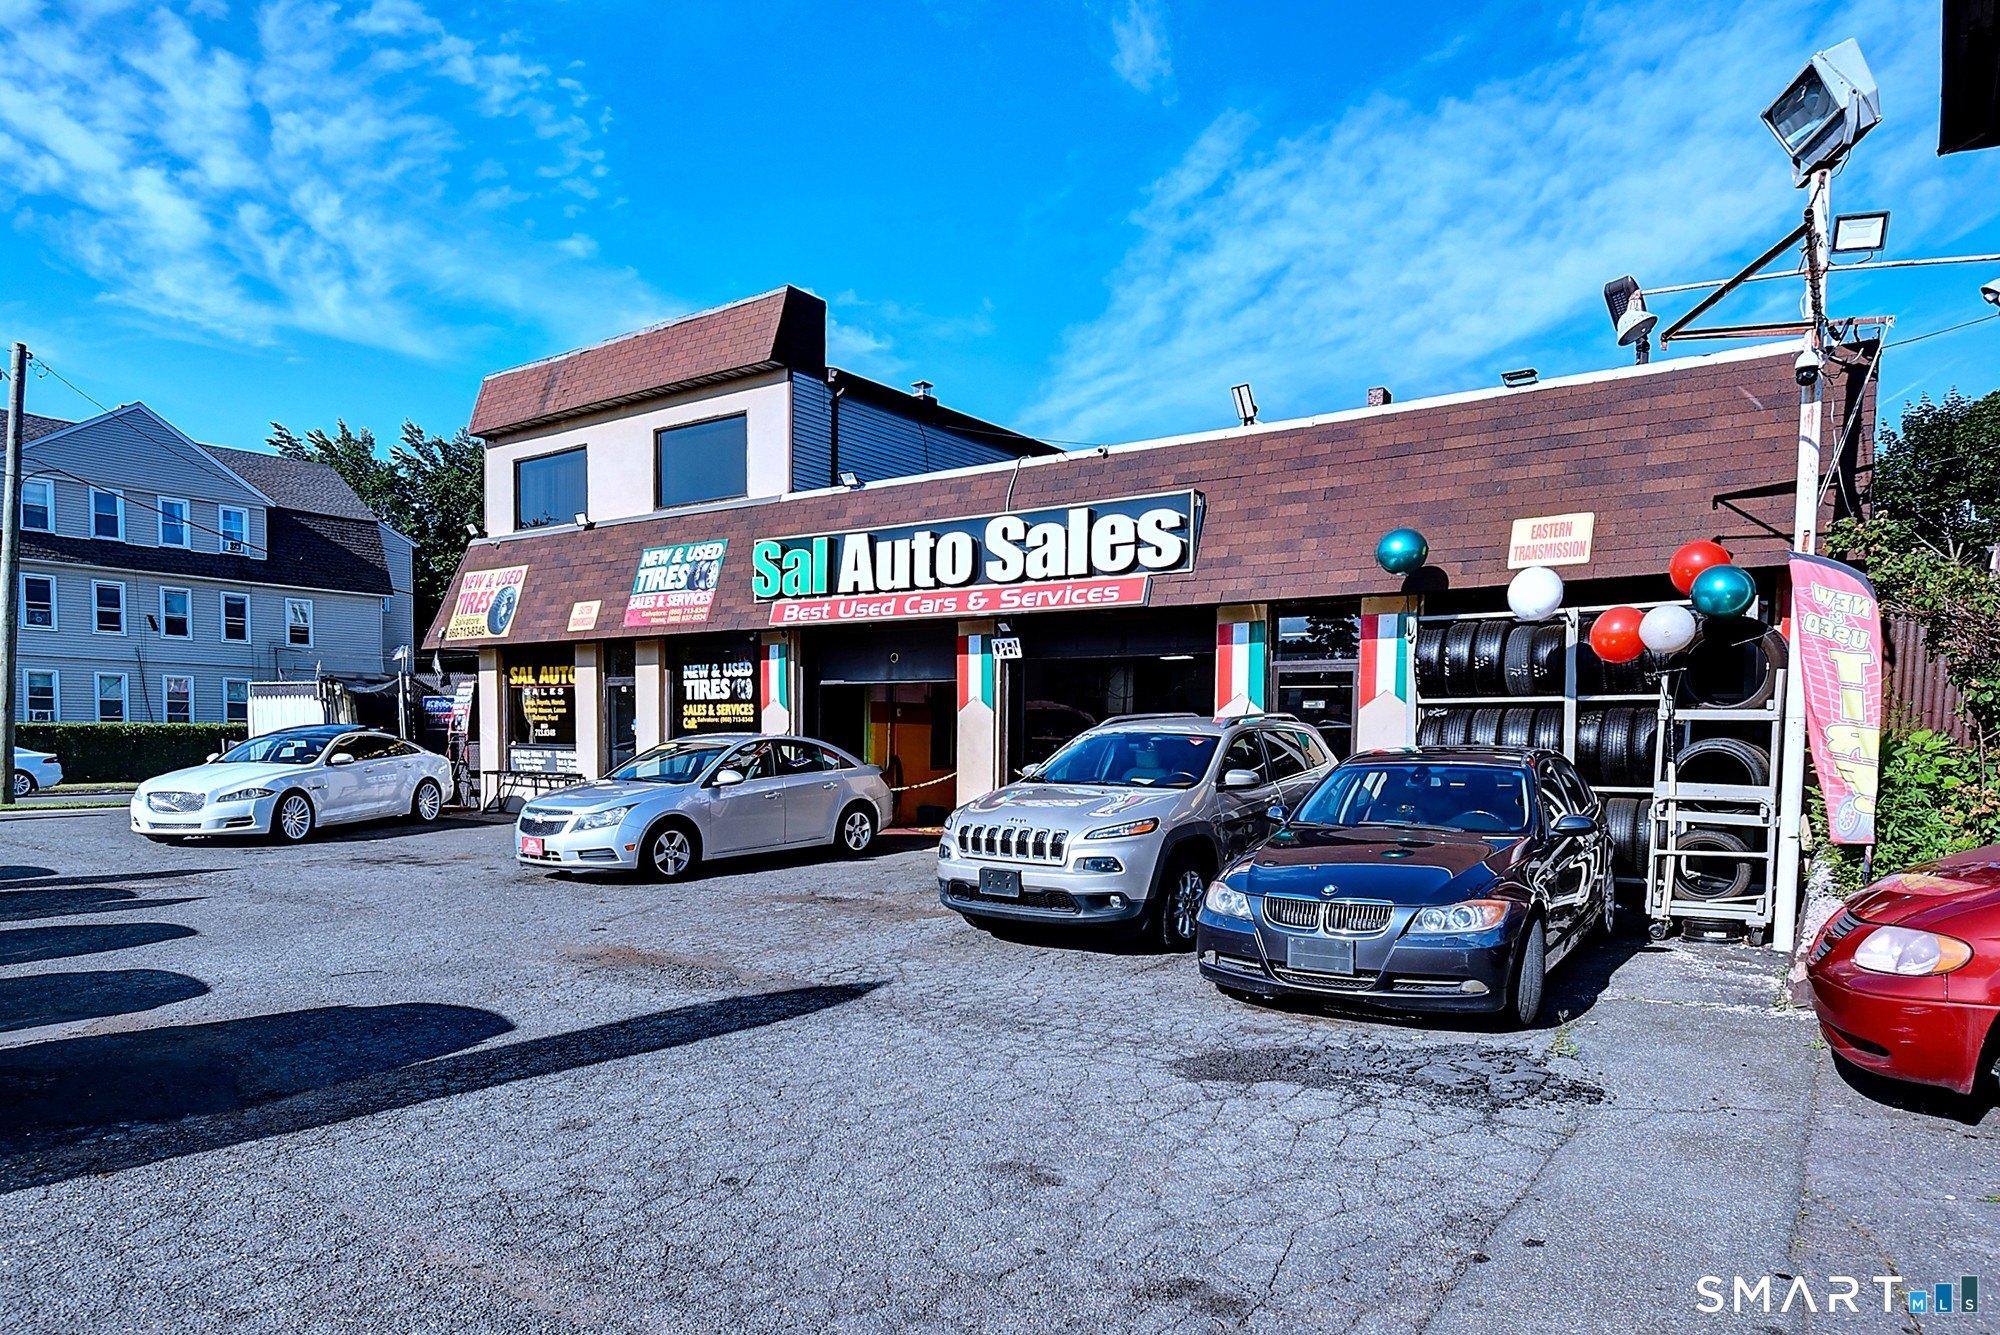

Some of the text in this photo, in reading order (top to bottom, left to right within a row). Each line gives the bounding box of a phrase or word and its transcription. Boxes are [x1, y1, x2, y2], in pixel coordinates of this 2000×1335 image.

[1530, 521, 1573, 540] EASTERN
[641, 542, 724, 568] NEW & USED
[752, 507, 1187, 598] Sal Auto Sales
[1514, 540, 1587, 562] TRANSMISSION
[463, 569, 523, 589] NEW & USED
[636, 563, 691, 594] TIRES
[456, 591, 495, 616] TIRES
[628, 591, 712, 611] SALES & SERVICES
[782, 584, 1121, 622] Best Used Cars & Services
[448, 625, 486, 638] 860-713-8348
[994, 640, 1019, 656] OPEN
[509, 666, 535, 685] SAL
[683, 661, 753, 679] NEW & USED
[523, 687, 564, 696] SALES
[683, 679, 730, 700] TIRES
[683, 703, 755, 716] SALES & SERVICES
